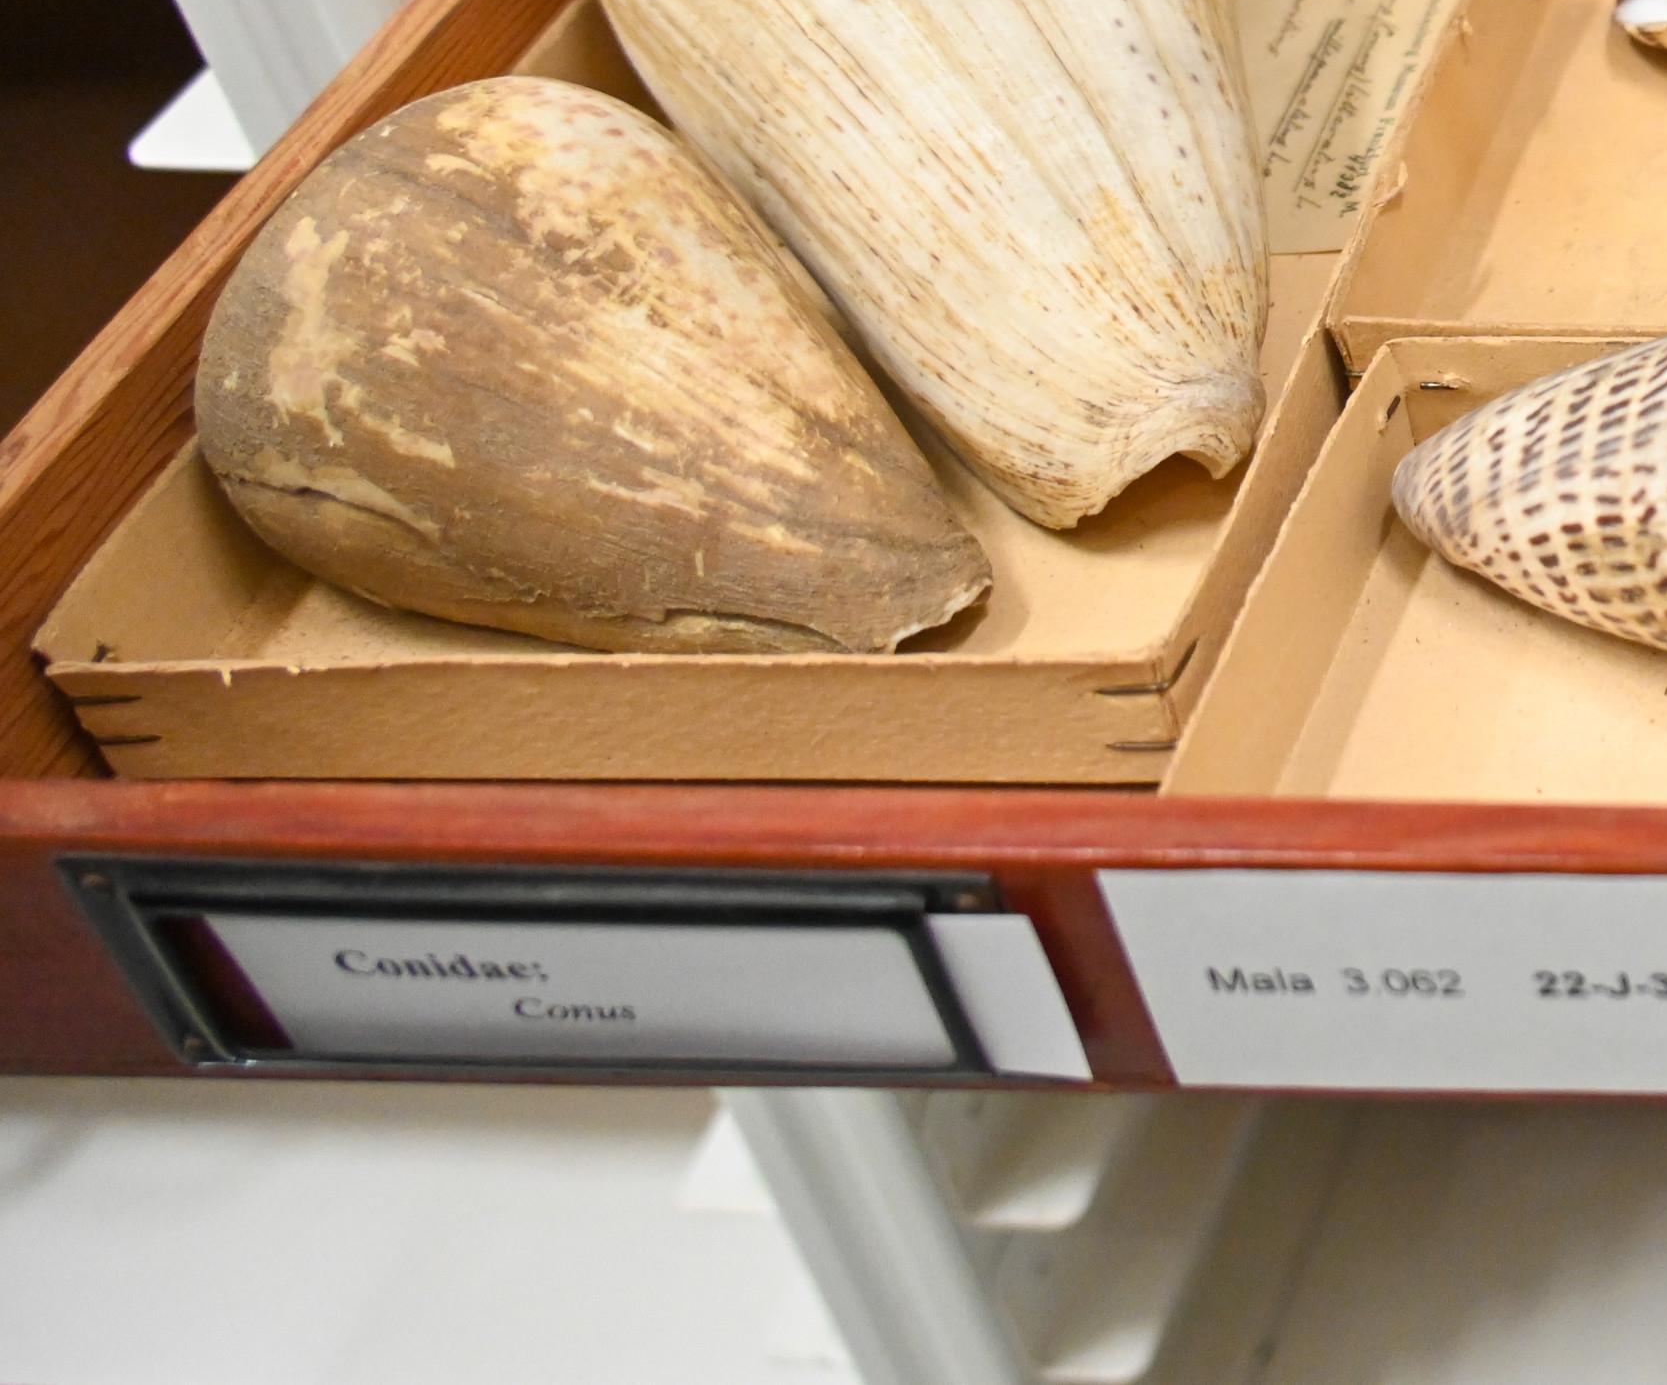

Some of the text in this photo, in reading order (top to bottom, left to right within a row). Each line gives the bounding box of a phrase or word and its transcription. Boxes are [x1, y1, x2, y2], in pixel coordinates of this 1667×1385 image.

[334, 949, 548, 982] Conidae:
[1206, 966, 1316, 994] Mala
[1340, 967, 1467, 997] 3.062
[513, 996, 637, 1020] Conus
